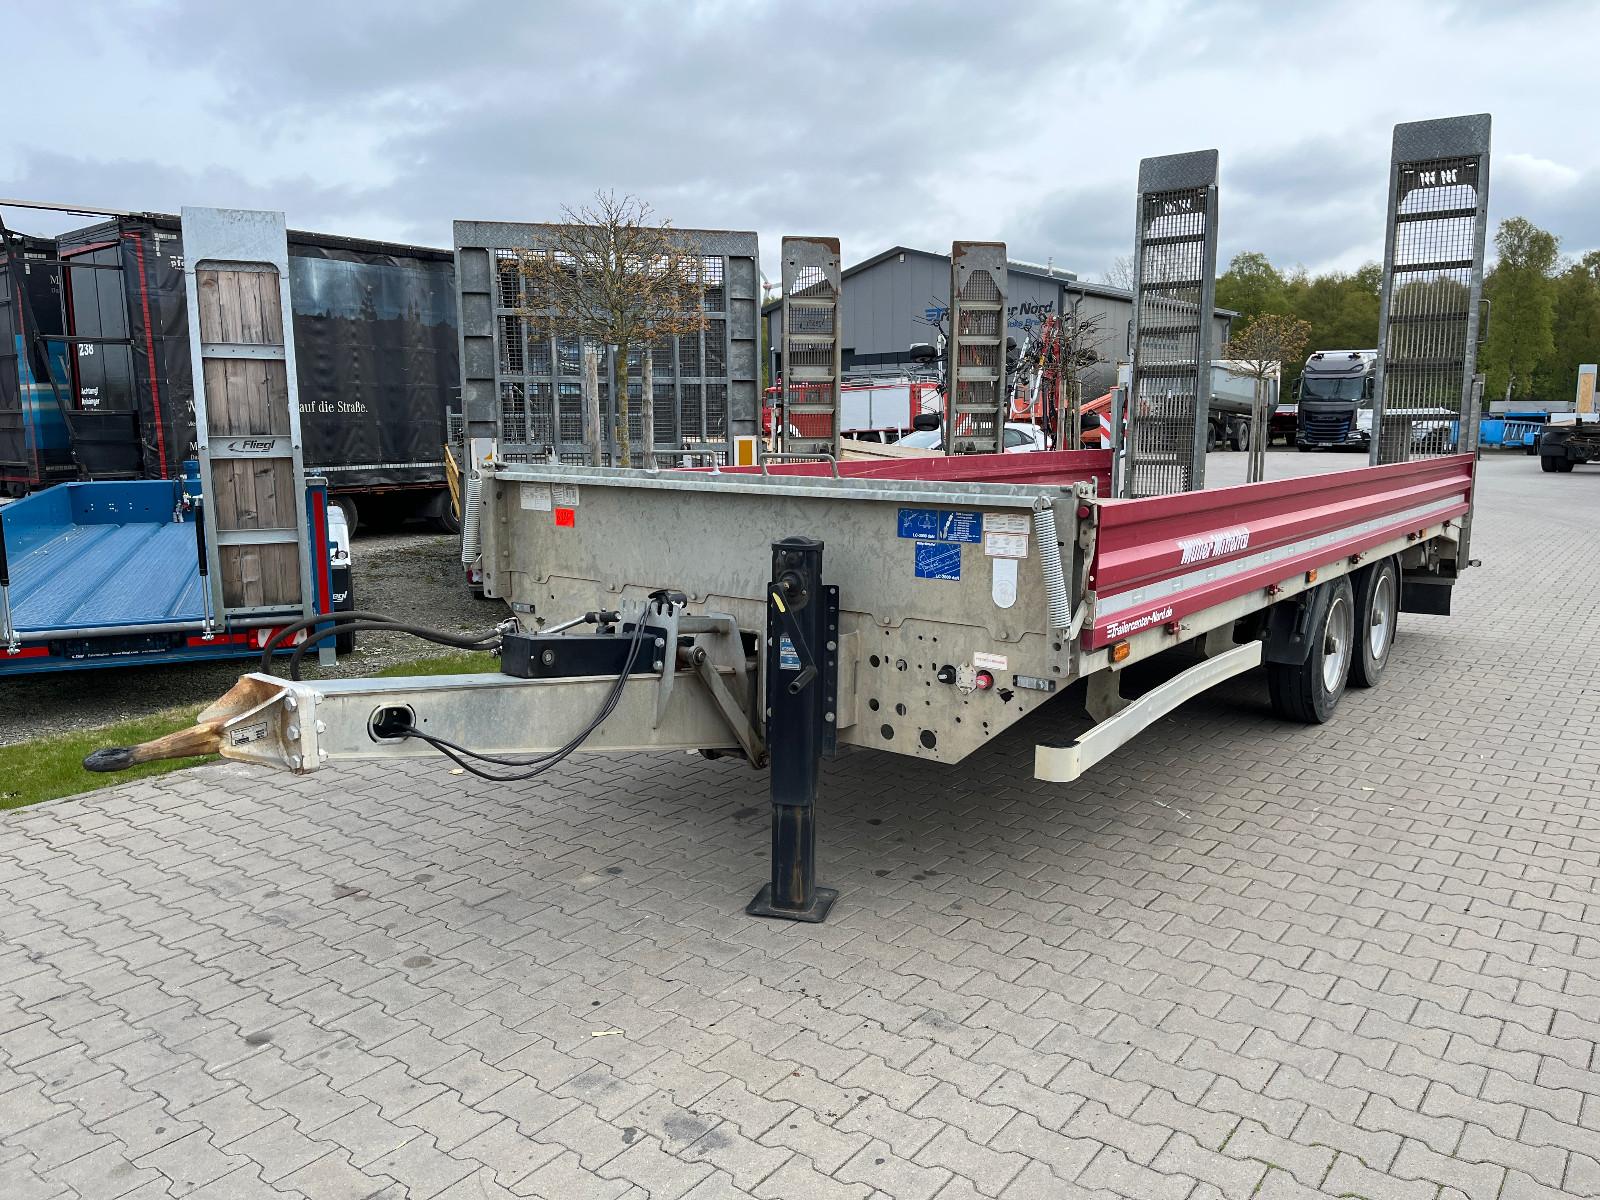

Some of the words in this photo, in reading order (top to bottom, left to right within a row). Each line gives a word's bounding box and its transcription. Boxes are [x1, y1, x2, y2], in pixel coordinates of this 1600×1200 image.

[1020, 300, 1054, 315] Nord
[79, 344, 93, 356] 238
[299, 401, 314, 413] auf
[318, 401, 335, 413] die
[337, 401, 369, 413] Straße.
[242, 440, 276, 451] Fliegl
[1107, 606, 1173, 638] Trailercenter-Nord.de
